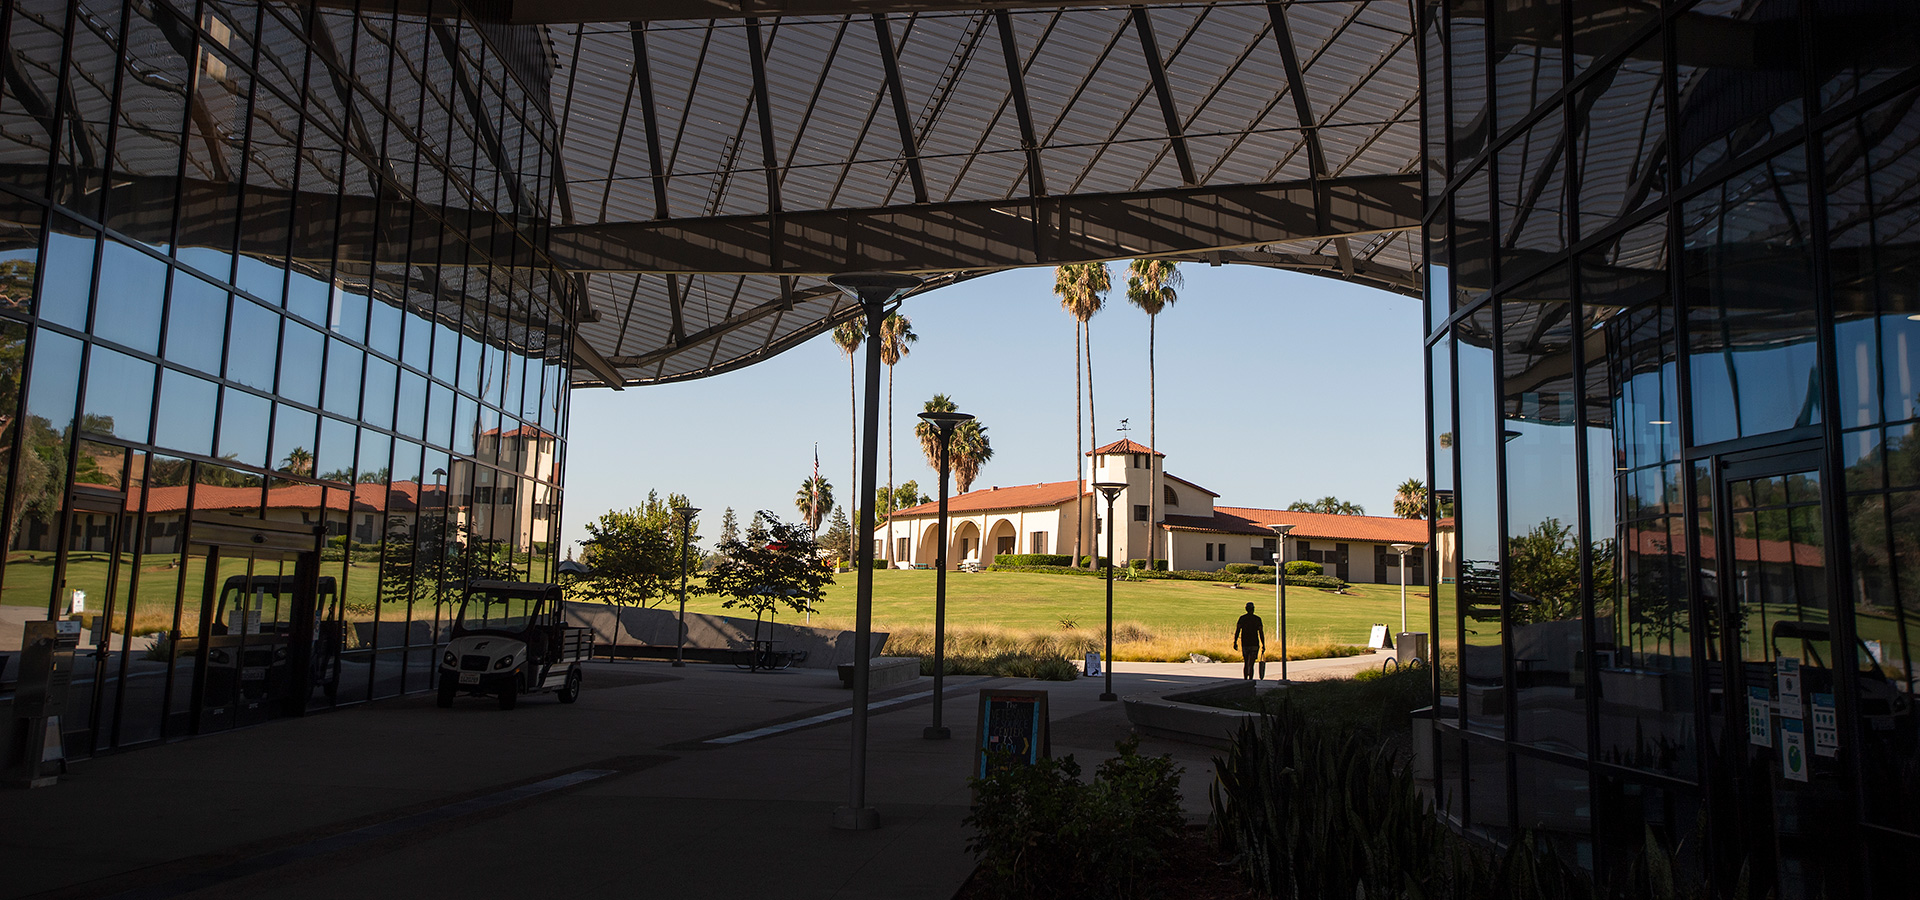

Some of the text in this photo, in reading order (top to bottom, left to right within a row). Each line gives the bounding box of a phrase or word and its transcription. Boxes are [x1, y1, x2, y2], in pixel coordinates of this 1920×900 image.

[991, 709, 1031, 720] VETERANS
[990, 719, 1029, 728] RESOURCE
[993, 727, 1024, 737] CENTER
